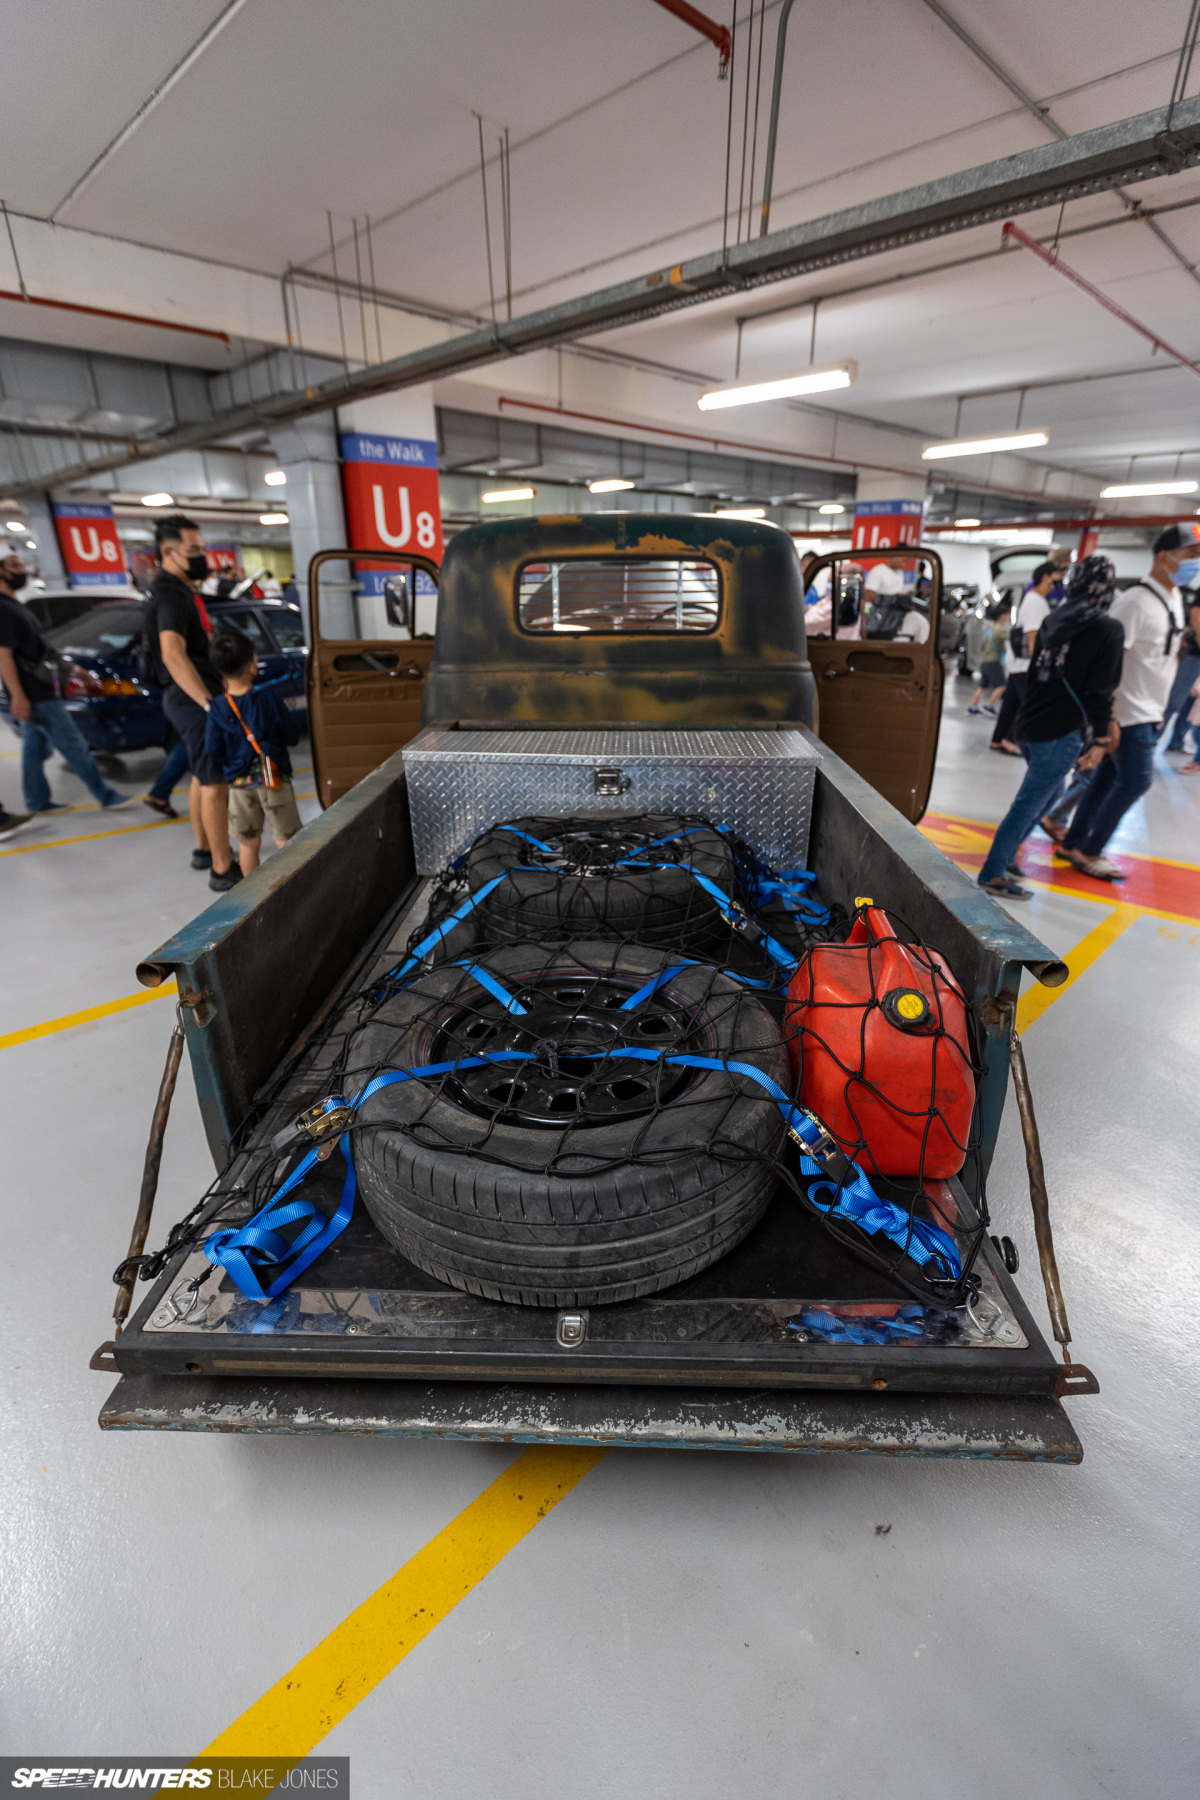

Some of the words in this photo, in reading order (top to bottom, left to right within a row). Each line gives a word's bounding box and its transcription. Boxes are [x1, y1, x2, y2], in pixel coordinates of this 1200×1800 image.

[359, 439, 385, 459] the
[387, 441, 424, 462] Walk
[372, 484, 436, 549] U8
[70, 527, 119, 563] U8
